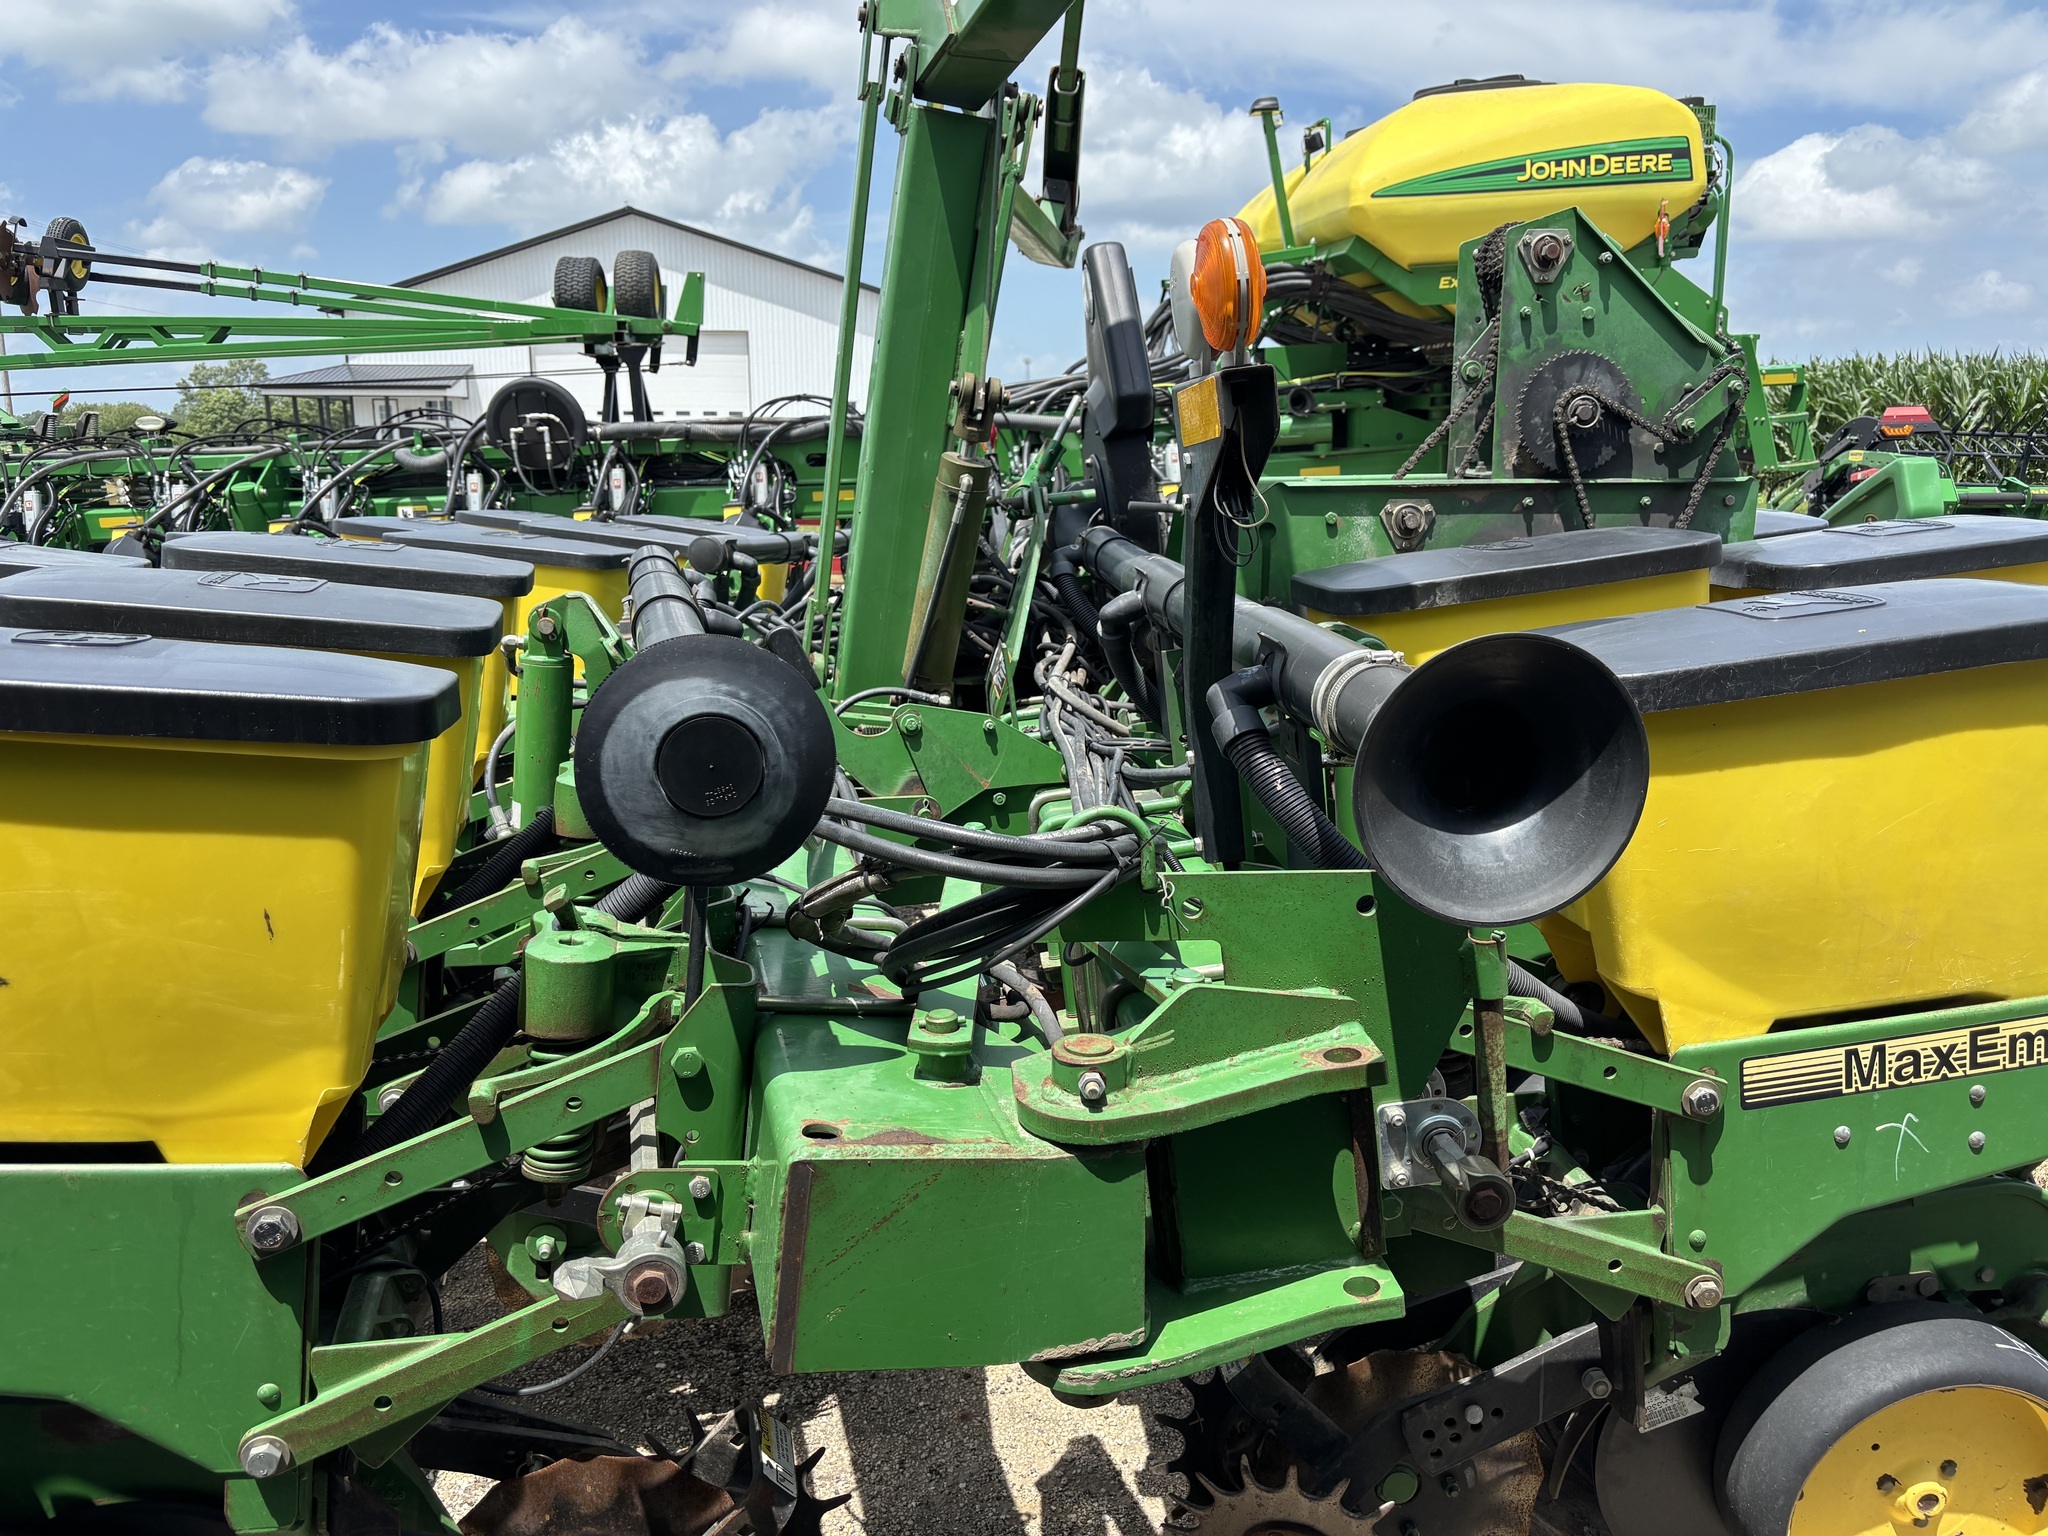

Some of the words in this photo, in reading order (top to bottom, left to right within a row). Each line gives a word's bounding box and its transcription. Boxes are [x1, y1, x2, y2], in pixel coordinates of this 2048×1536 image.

[1517, 158, 1586, 182] JOHN
[1590, 153, 1673, 177] DEERE
[1843, 1026, 2048, 1090] MaxEm
